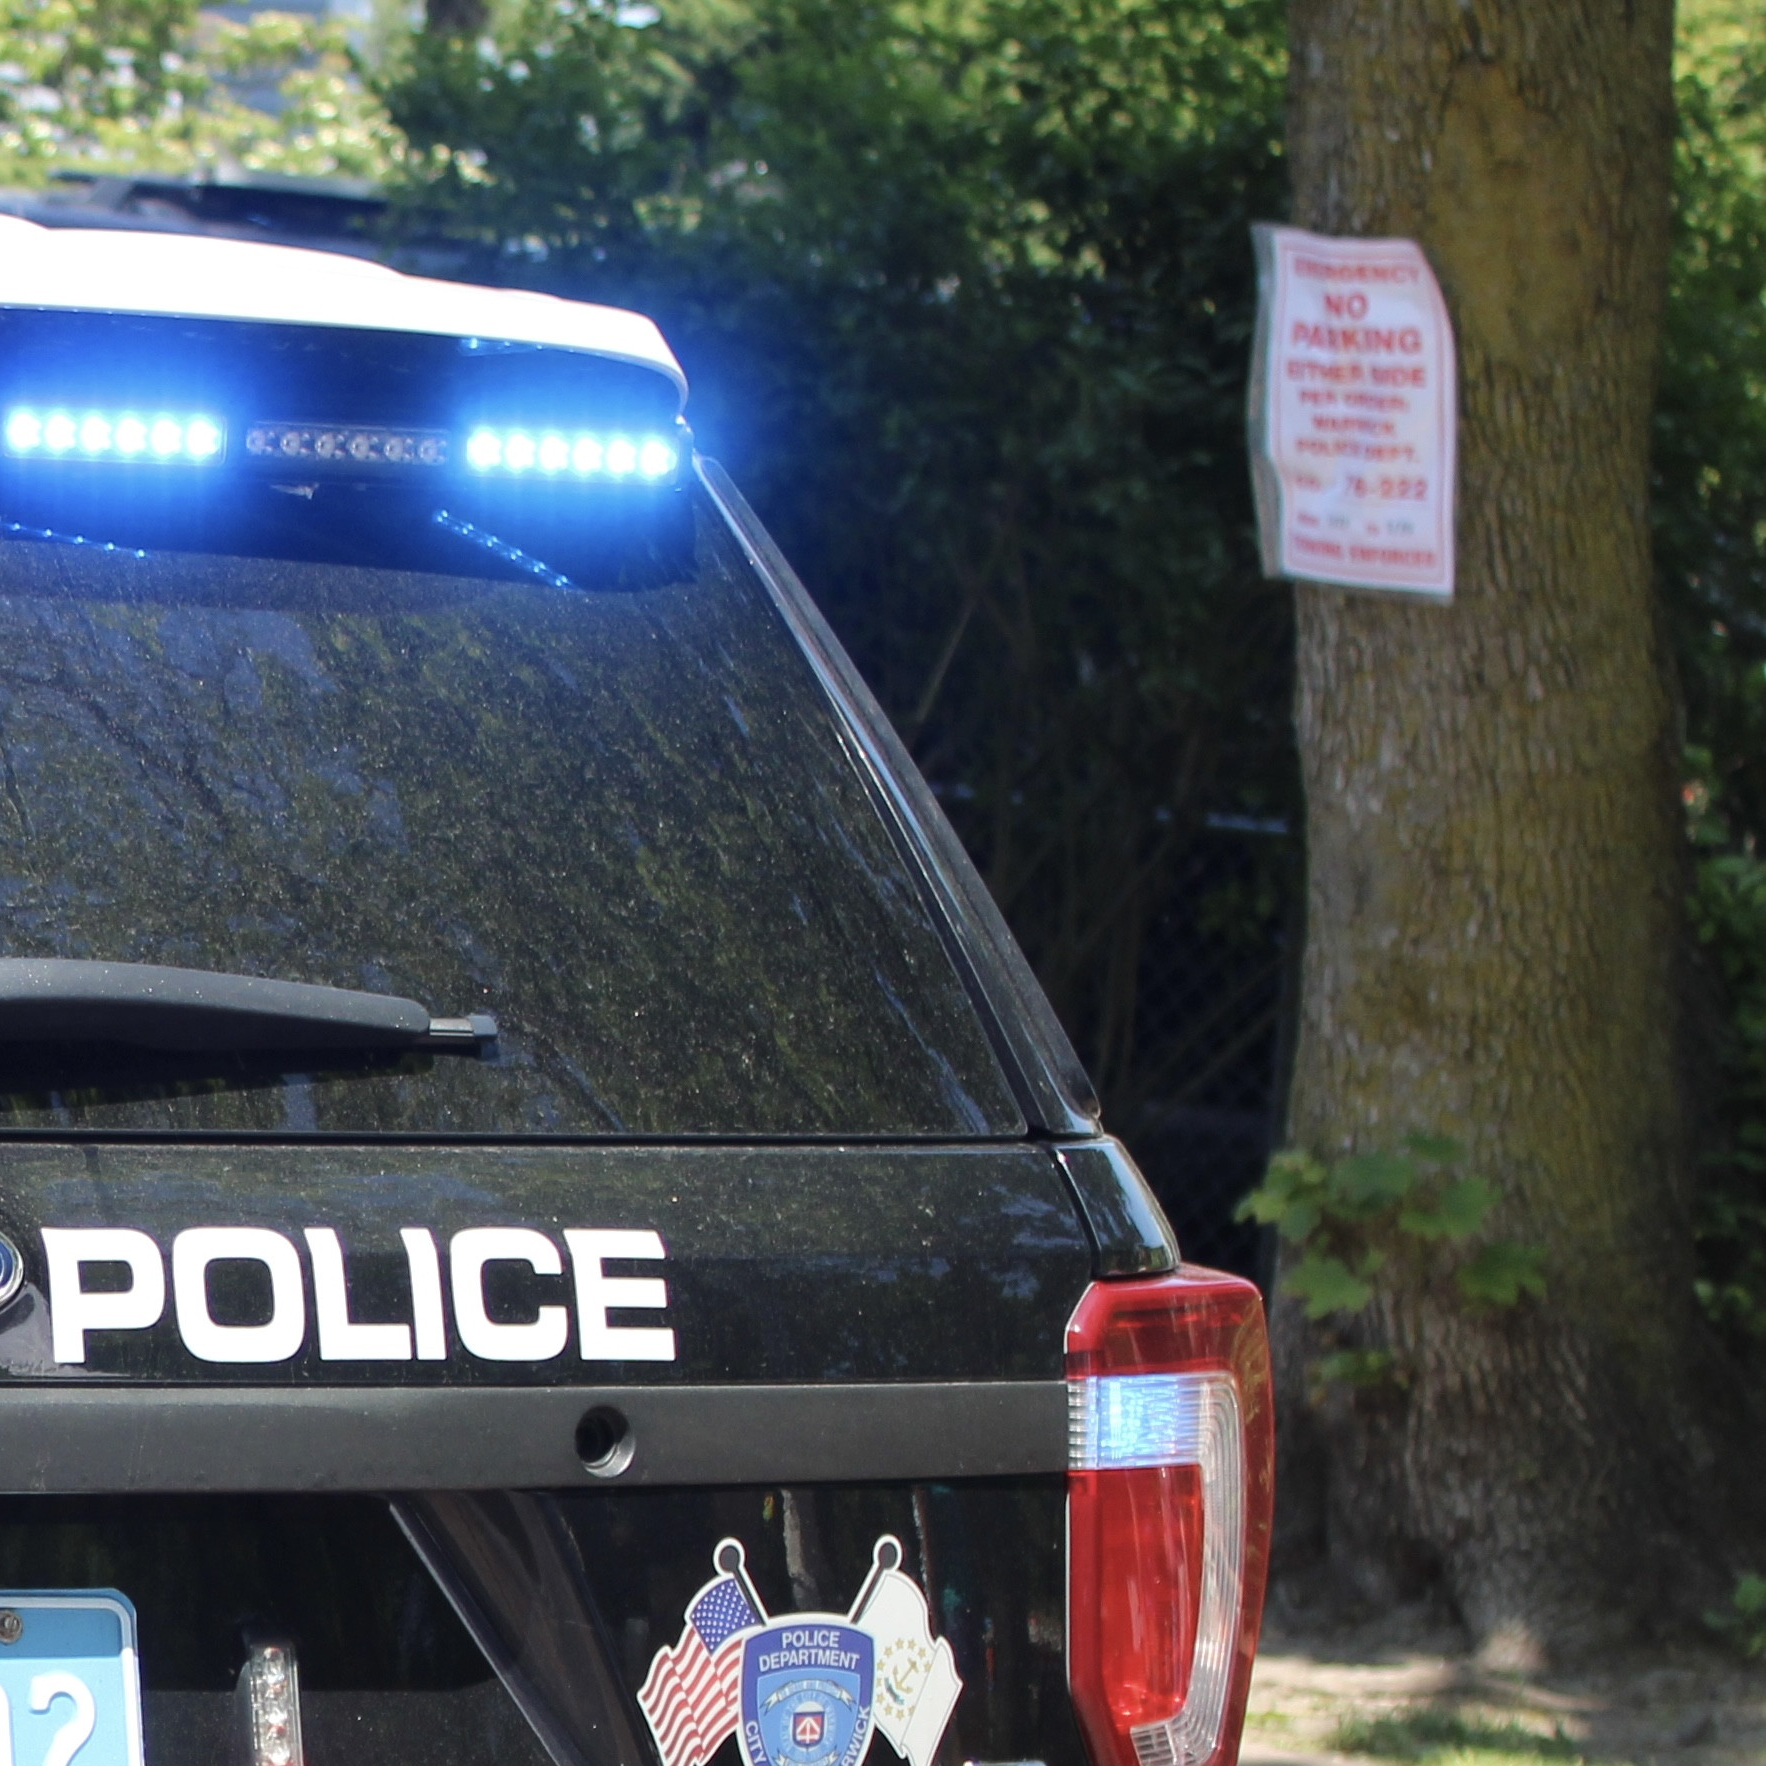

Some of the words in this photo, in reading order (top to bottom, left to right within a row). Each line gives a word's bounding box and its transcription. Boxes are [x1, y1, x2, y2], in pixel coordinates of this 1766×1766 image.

[1324, 293, 1367, 319] NO
[1291, 322, 1422, 354] PARKING
[1288, 361, 1363, 385] EITHER
[1371, 366, 1425, 389] SIDE
[39, 1226, 676, 1365] POLICE
[782, 1631, 841, 1649] POLICE
[758, 1651, 860, 1672] DEPARTMENT
[745, 1720, 767, 1766] CITY
